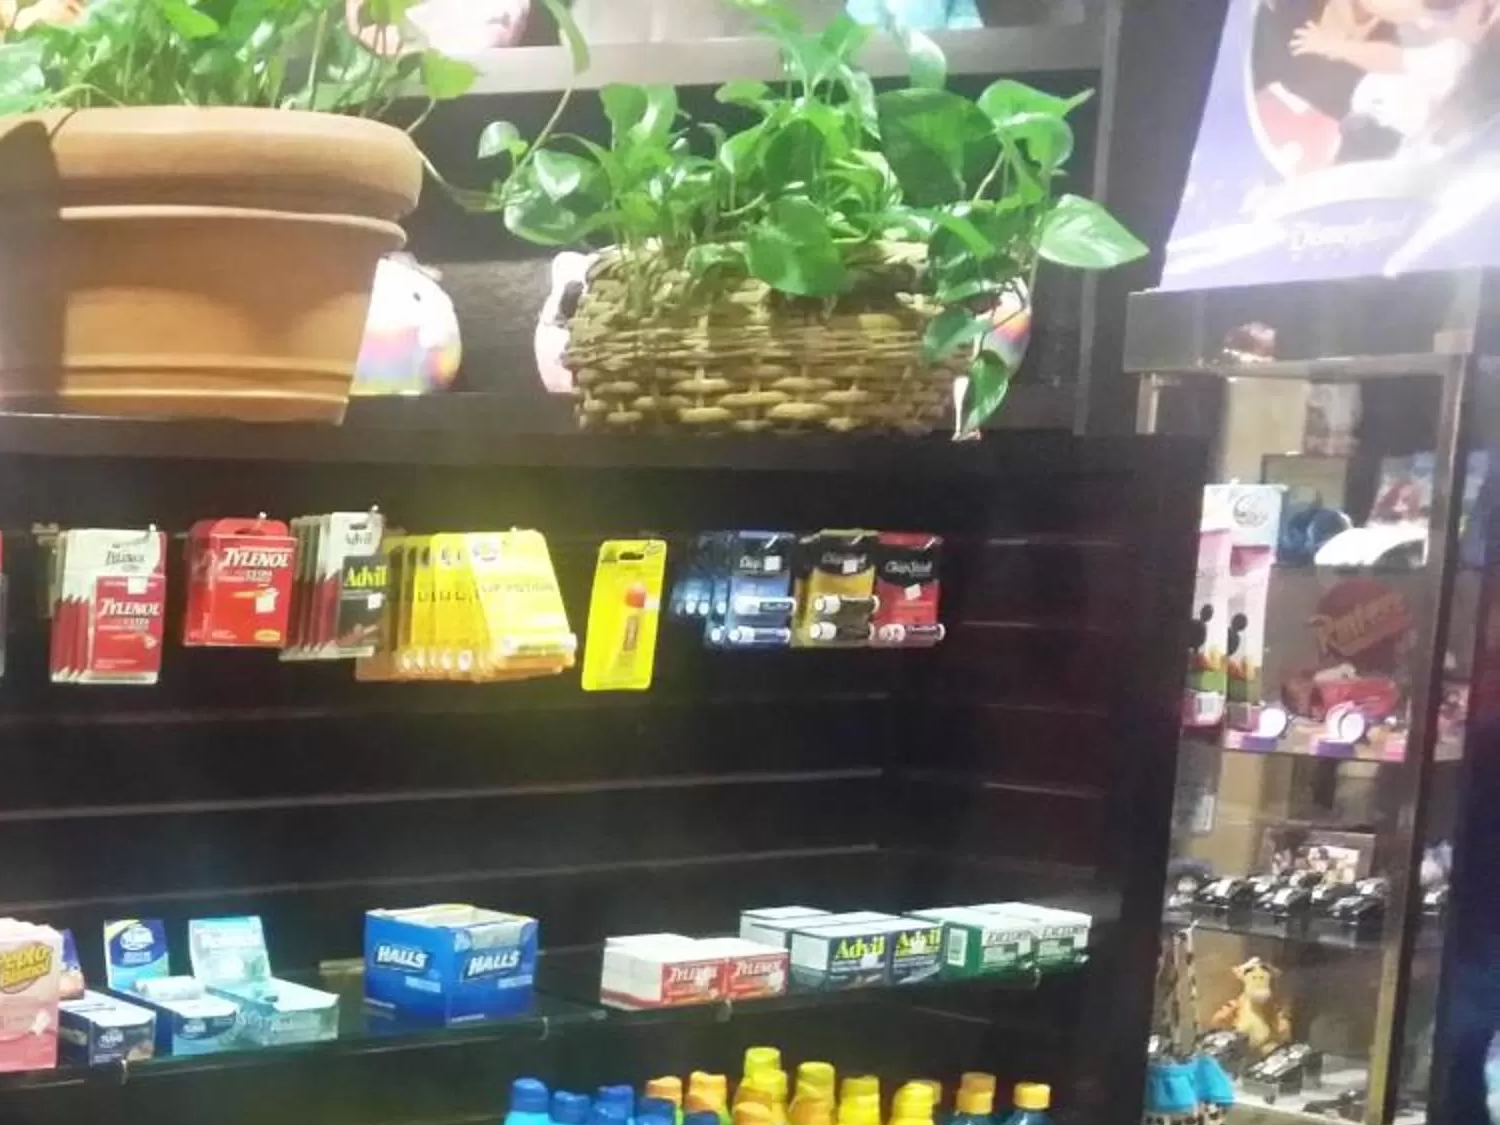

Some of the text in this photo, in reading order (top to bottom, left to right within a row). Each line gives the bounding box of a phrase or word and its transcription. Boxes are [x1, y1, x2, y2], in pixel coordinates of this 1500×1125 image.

[223, 550, 290, 570] TYLENOL
[347, 565, 388, 588] Advil
[99, 598, 161, 618] TYLENOL
[836, 935, 885, 960] Advil
[896, 928, 942, 952] Advil
[377, 945, 429, 969] HALLS
[468, 950, 521, 976] HALLS
